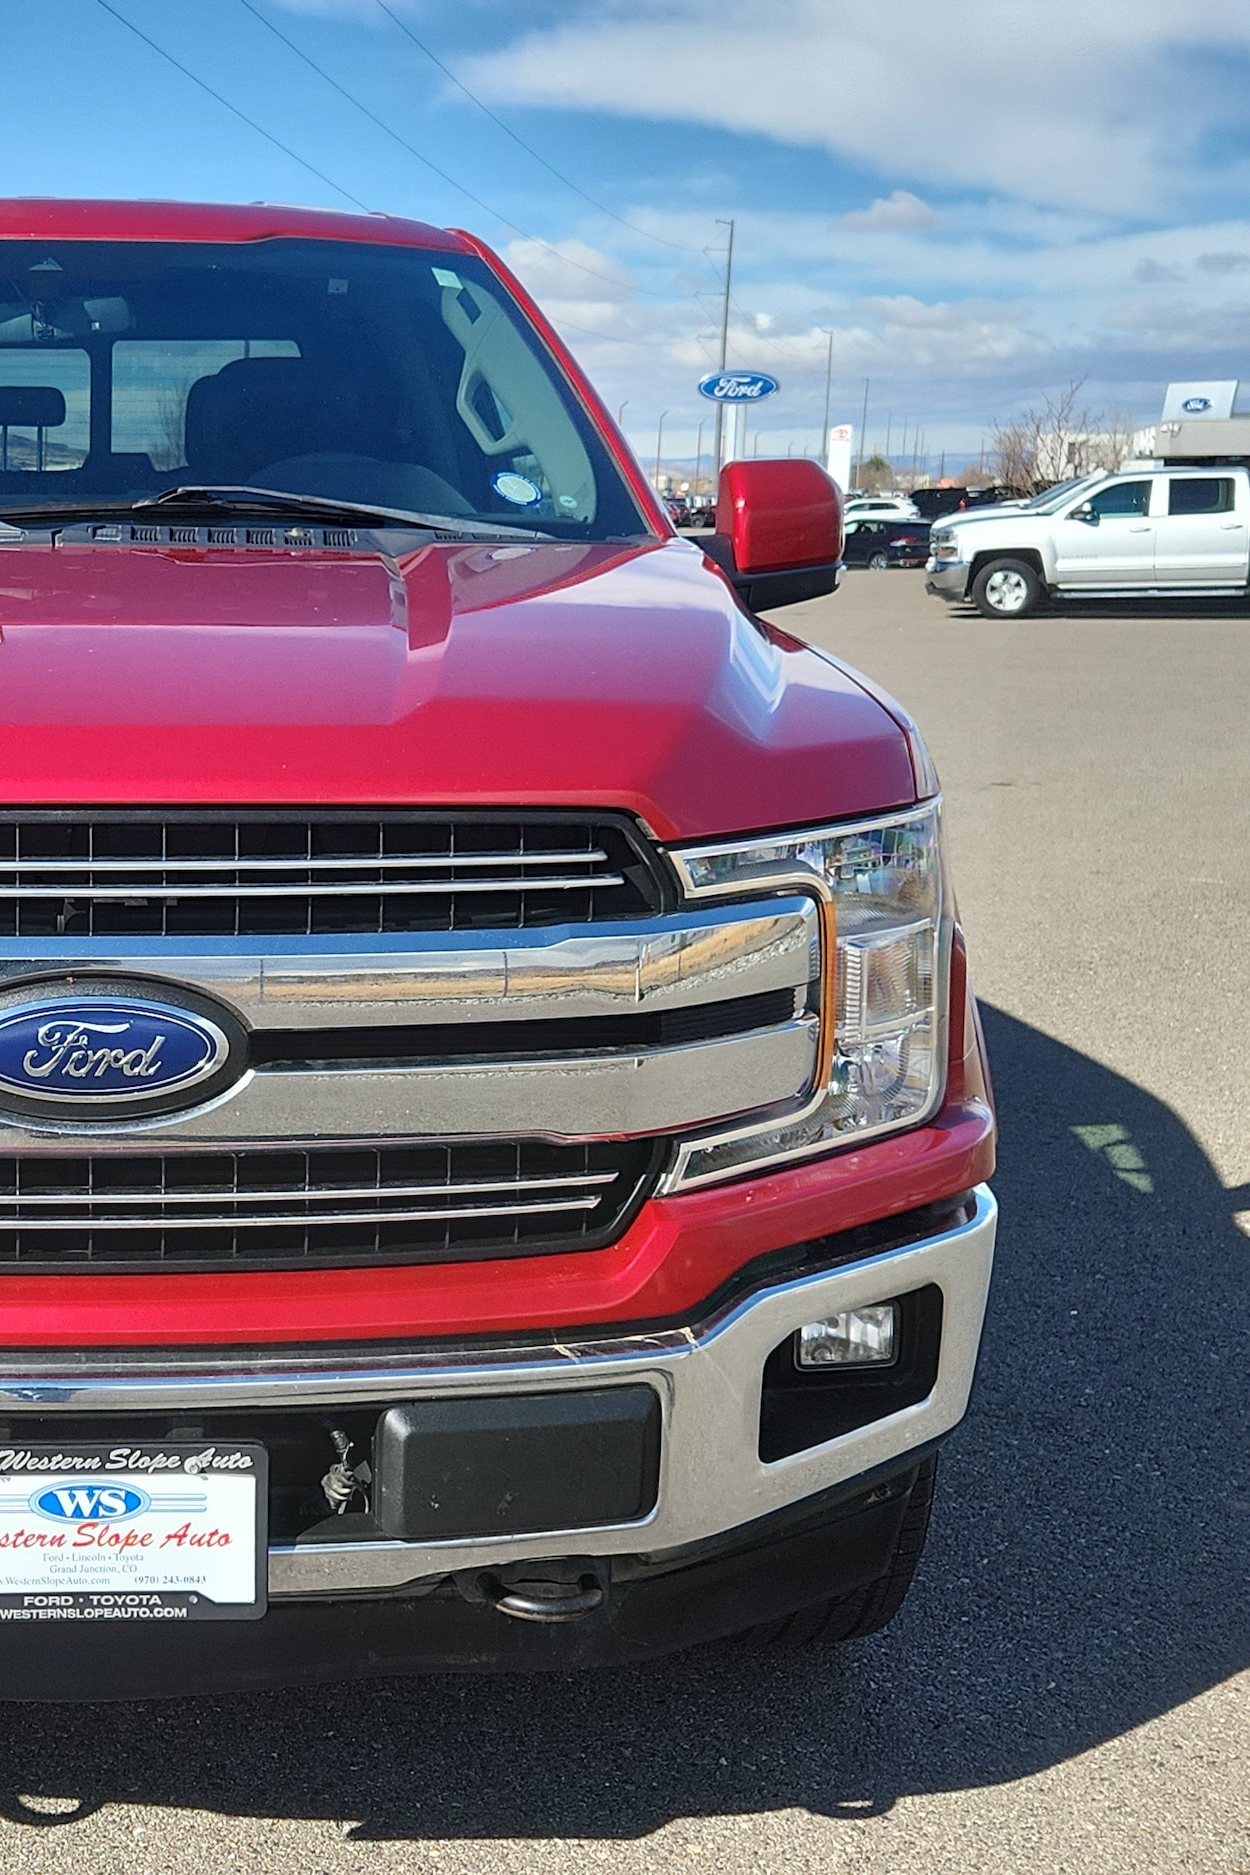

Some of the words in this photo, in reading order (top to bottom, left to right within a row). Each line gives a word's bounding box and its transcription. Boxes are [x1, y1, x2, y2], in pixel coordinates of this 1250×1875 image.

[713, 376, 764, 397] Ford
[22, 1019, 167, 1079] Ford
[104, 1447, 182, 1474] Slope
[193, 1447, 254, 1470] Auto
[52, 1488, 127, 1518] WS
[71, 1521, 154, 1555] Slope
[159, 1522, 234, 1549] Auto
[43, 1552, 65, 1563] Ford
[71, 1552, 107, 1563] Lincoln
[114, 1552, 145, 1564] Toyota
[49, 1564, 78, 1575] Grand
[80, 1564, 121, 1576] Junction,
[121, 1564, 139, 1574] CO
[134, 1575, 160, 1586] (970)
[162, 1575, 207, 1586] 243-0843
[23, 1596, 75, 1607] FORD
[89, 1594, 163, 1606] TOYOTA
[0, 1607, 188, 1621] WESTERNSLOPEAUTO.COM
